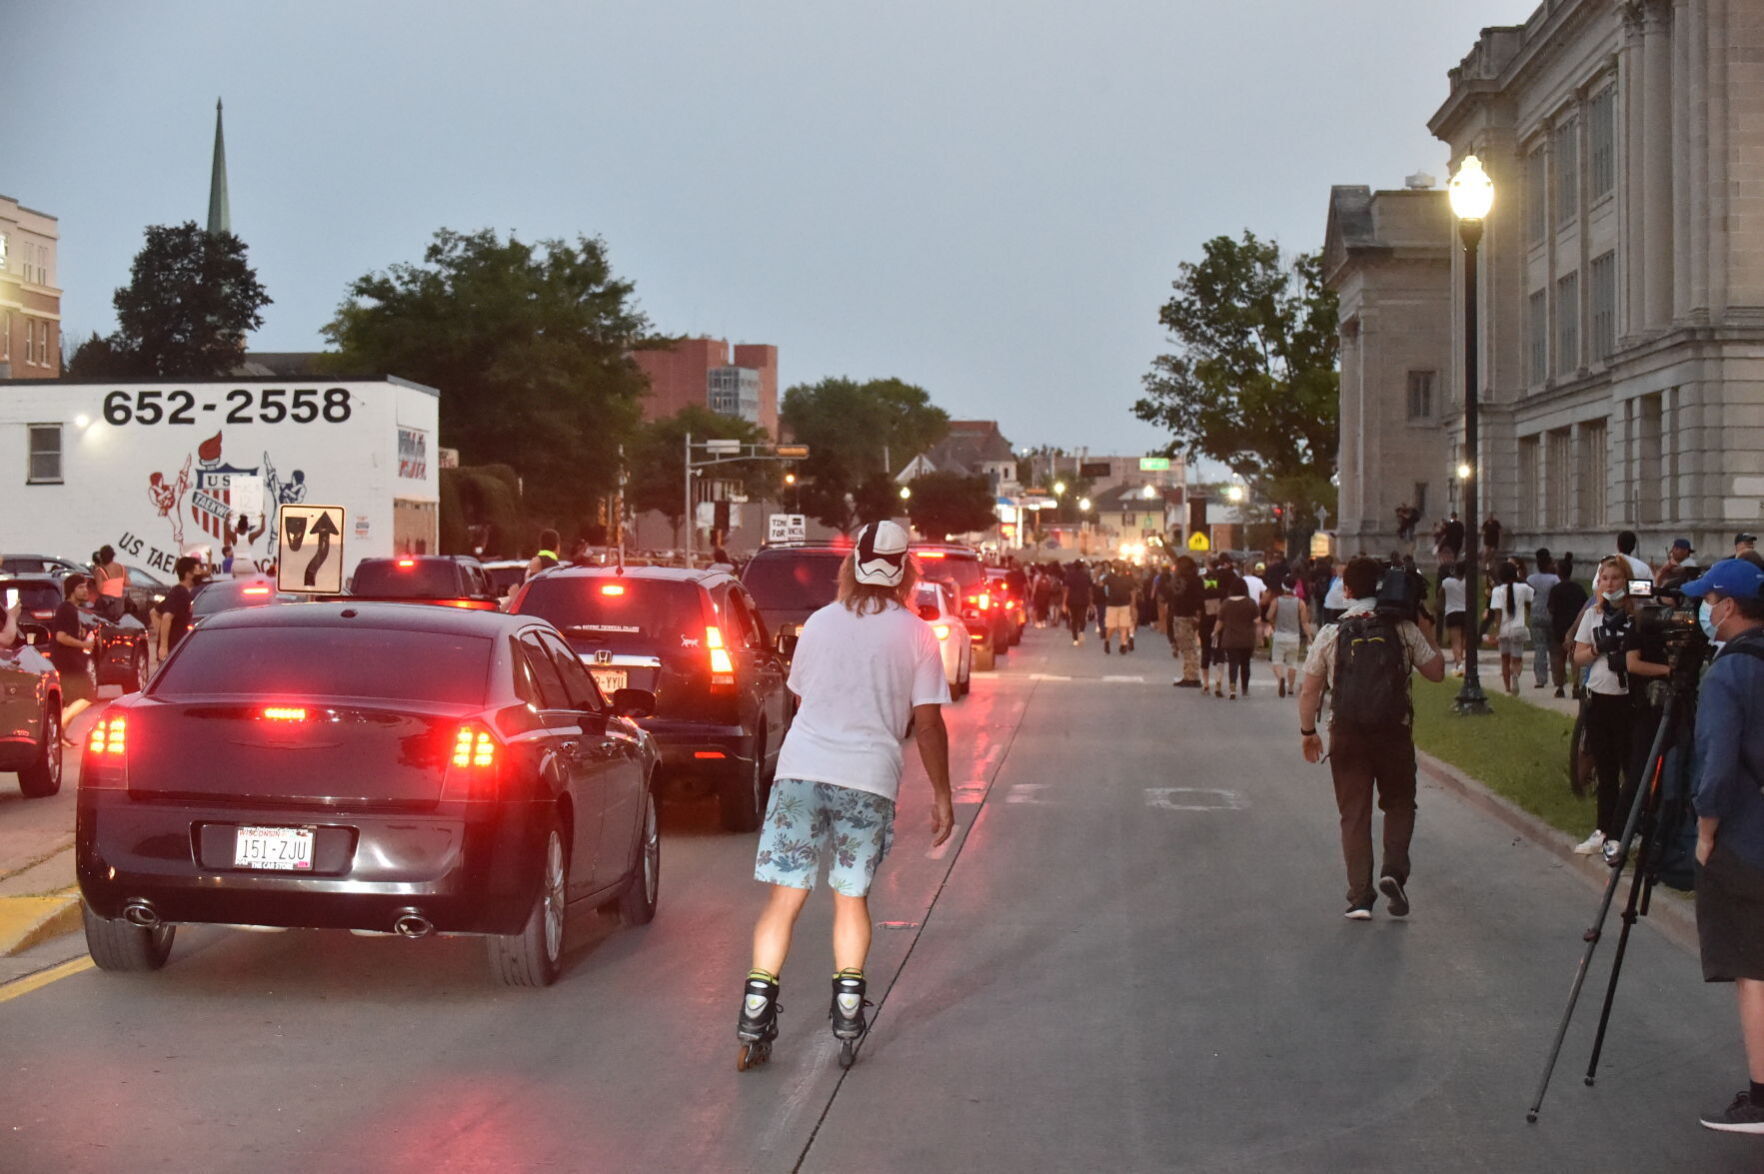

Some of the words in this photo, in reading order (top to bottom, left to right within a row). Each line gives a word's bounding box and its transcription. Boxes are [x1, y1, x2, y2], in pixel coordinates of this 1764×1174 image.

[103, 388, 352, 426] 652-2558
[118, 532, 145, 558] U.S.
[242, 839, 306, 860] 151-ZJU
